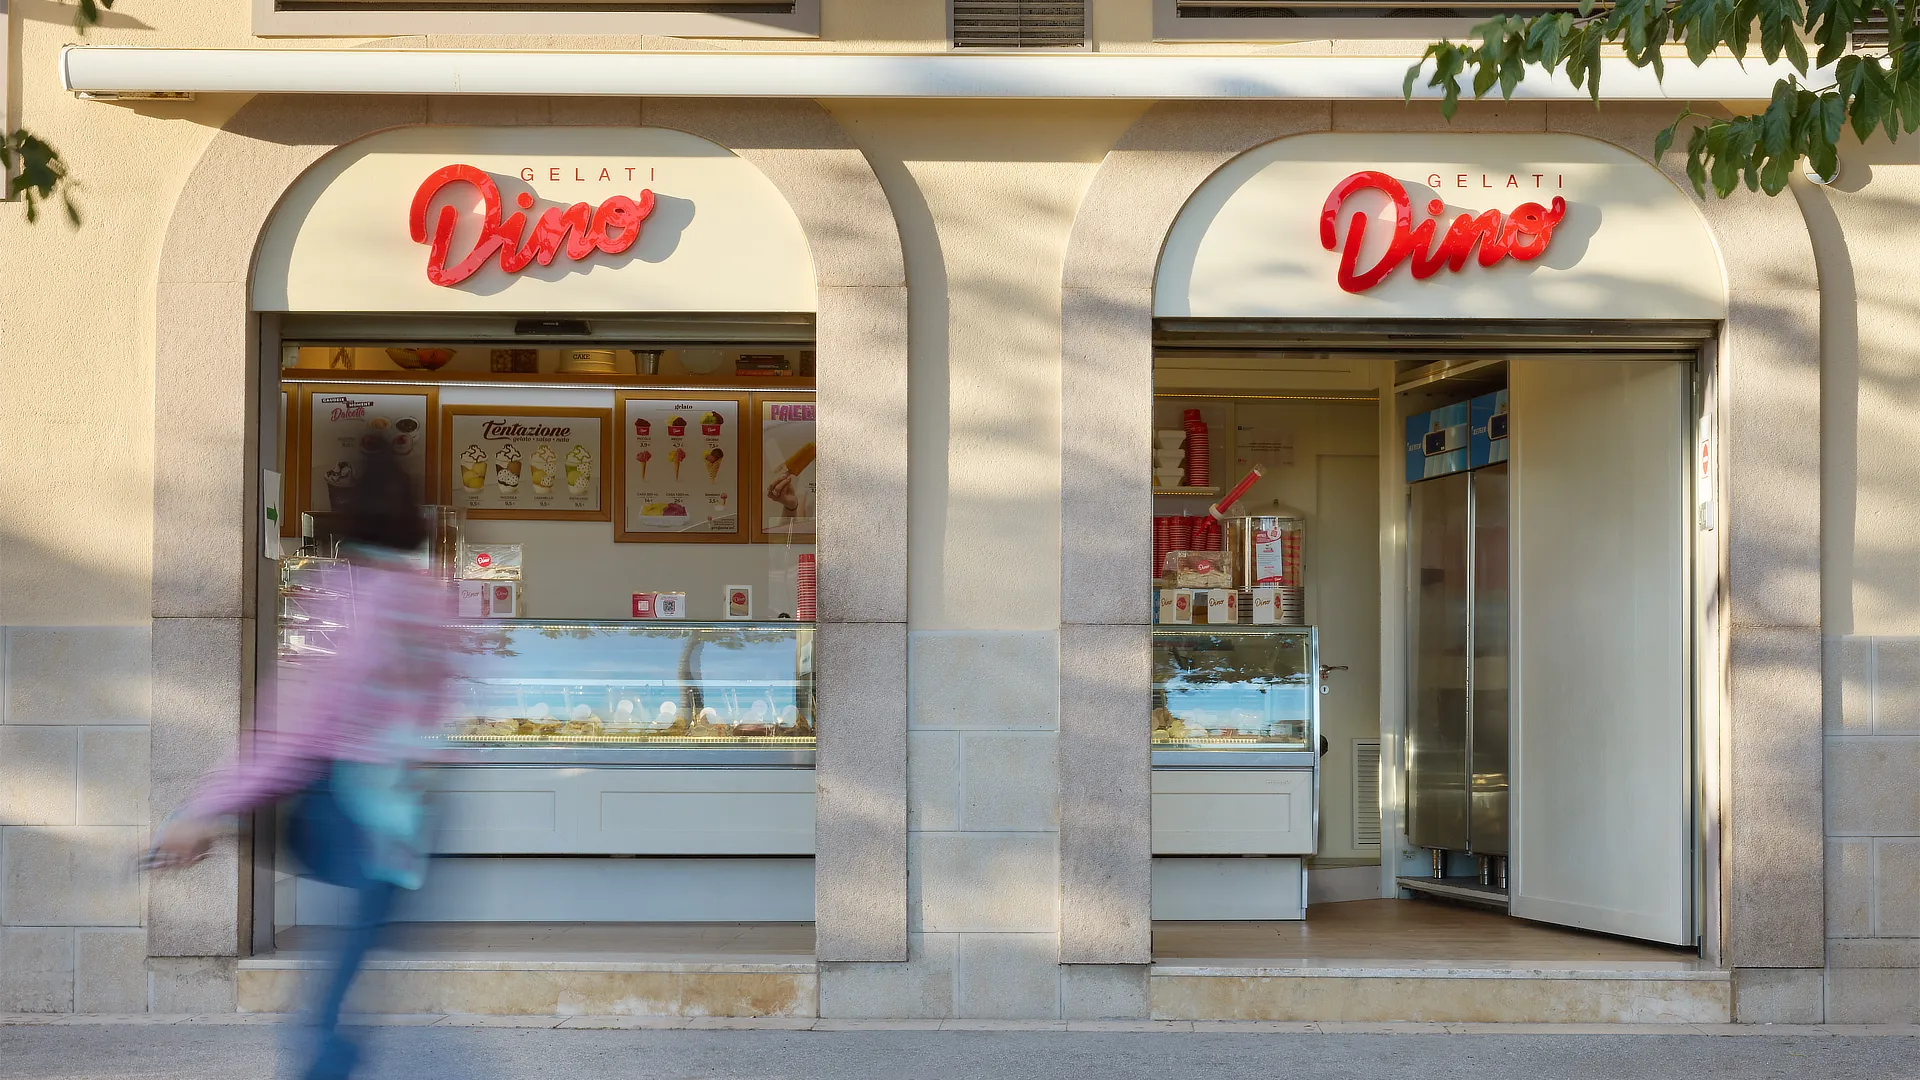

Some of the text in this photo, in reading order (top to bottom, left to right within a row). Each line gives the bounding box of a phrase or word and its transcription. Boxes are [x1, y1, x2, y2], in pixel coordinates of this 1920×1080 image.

[520, 167, 657, 182] GELATI
[1427, 173, 1564, 189] GELATI
[409, 163, 655, 287] Dino
[1319, 170, 1566, 293] Dino
[482, 419, 571, 440] Tentazione
[461, 589, 480, 599] Dino
[1209, 597, 1225, 607] Dino
[1254, 597, 1271, 607] Dino
